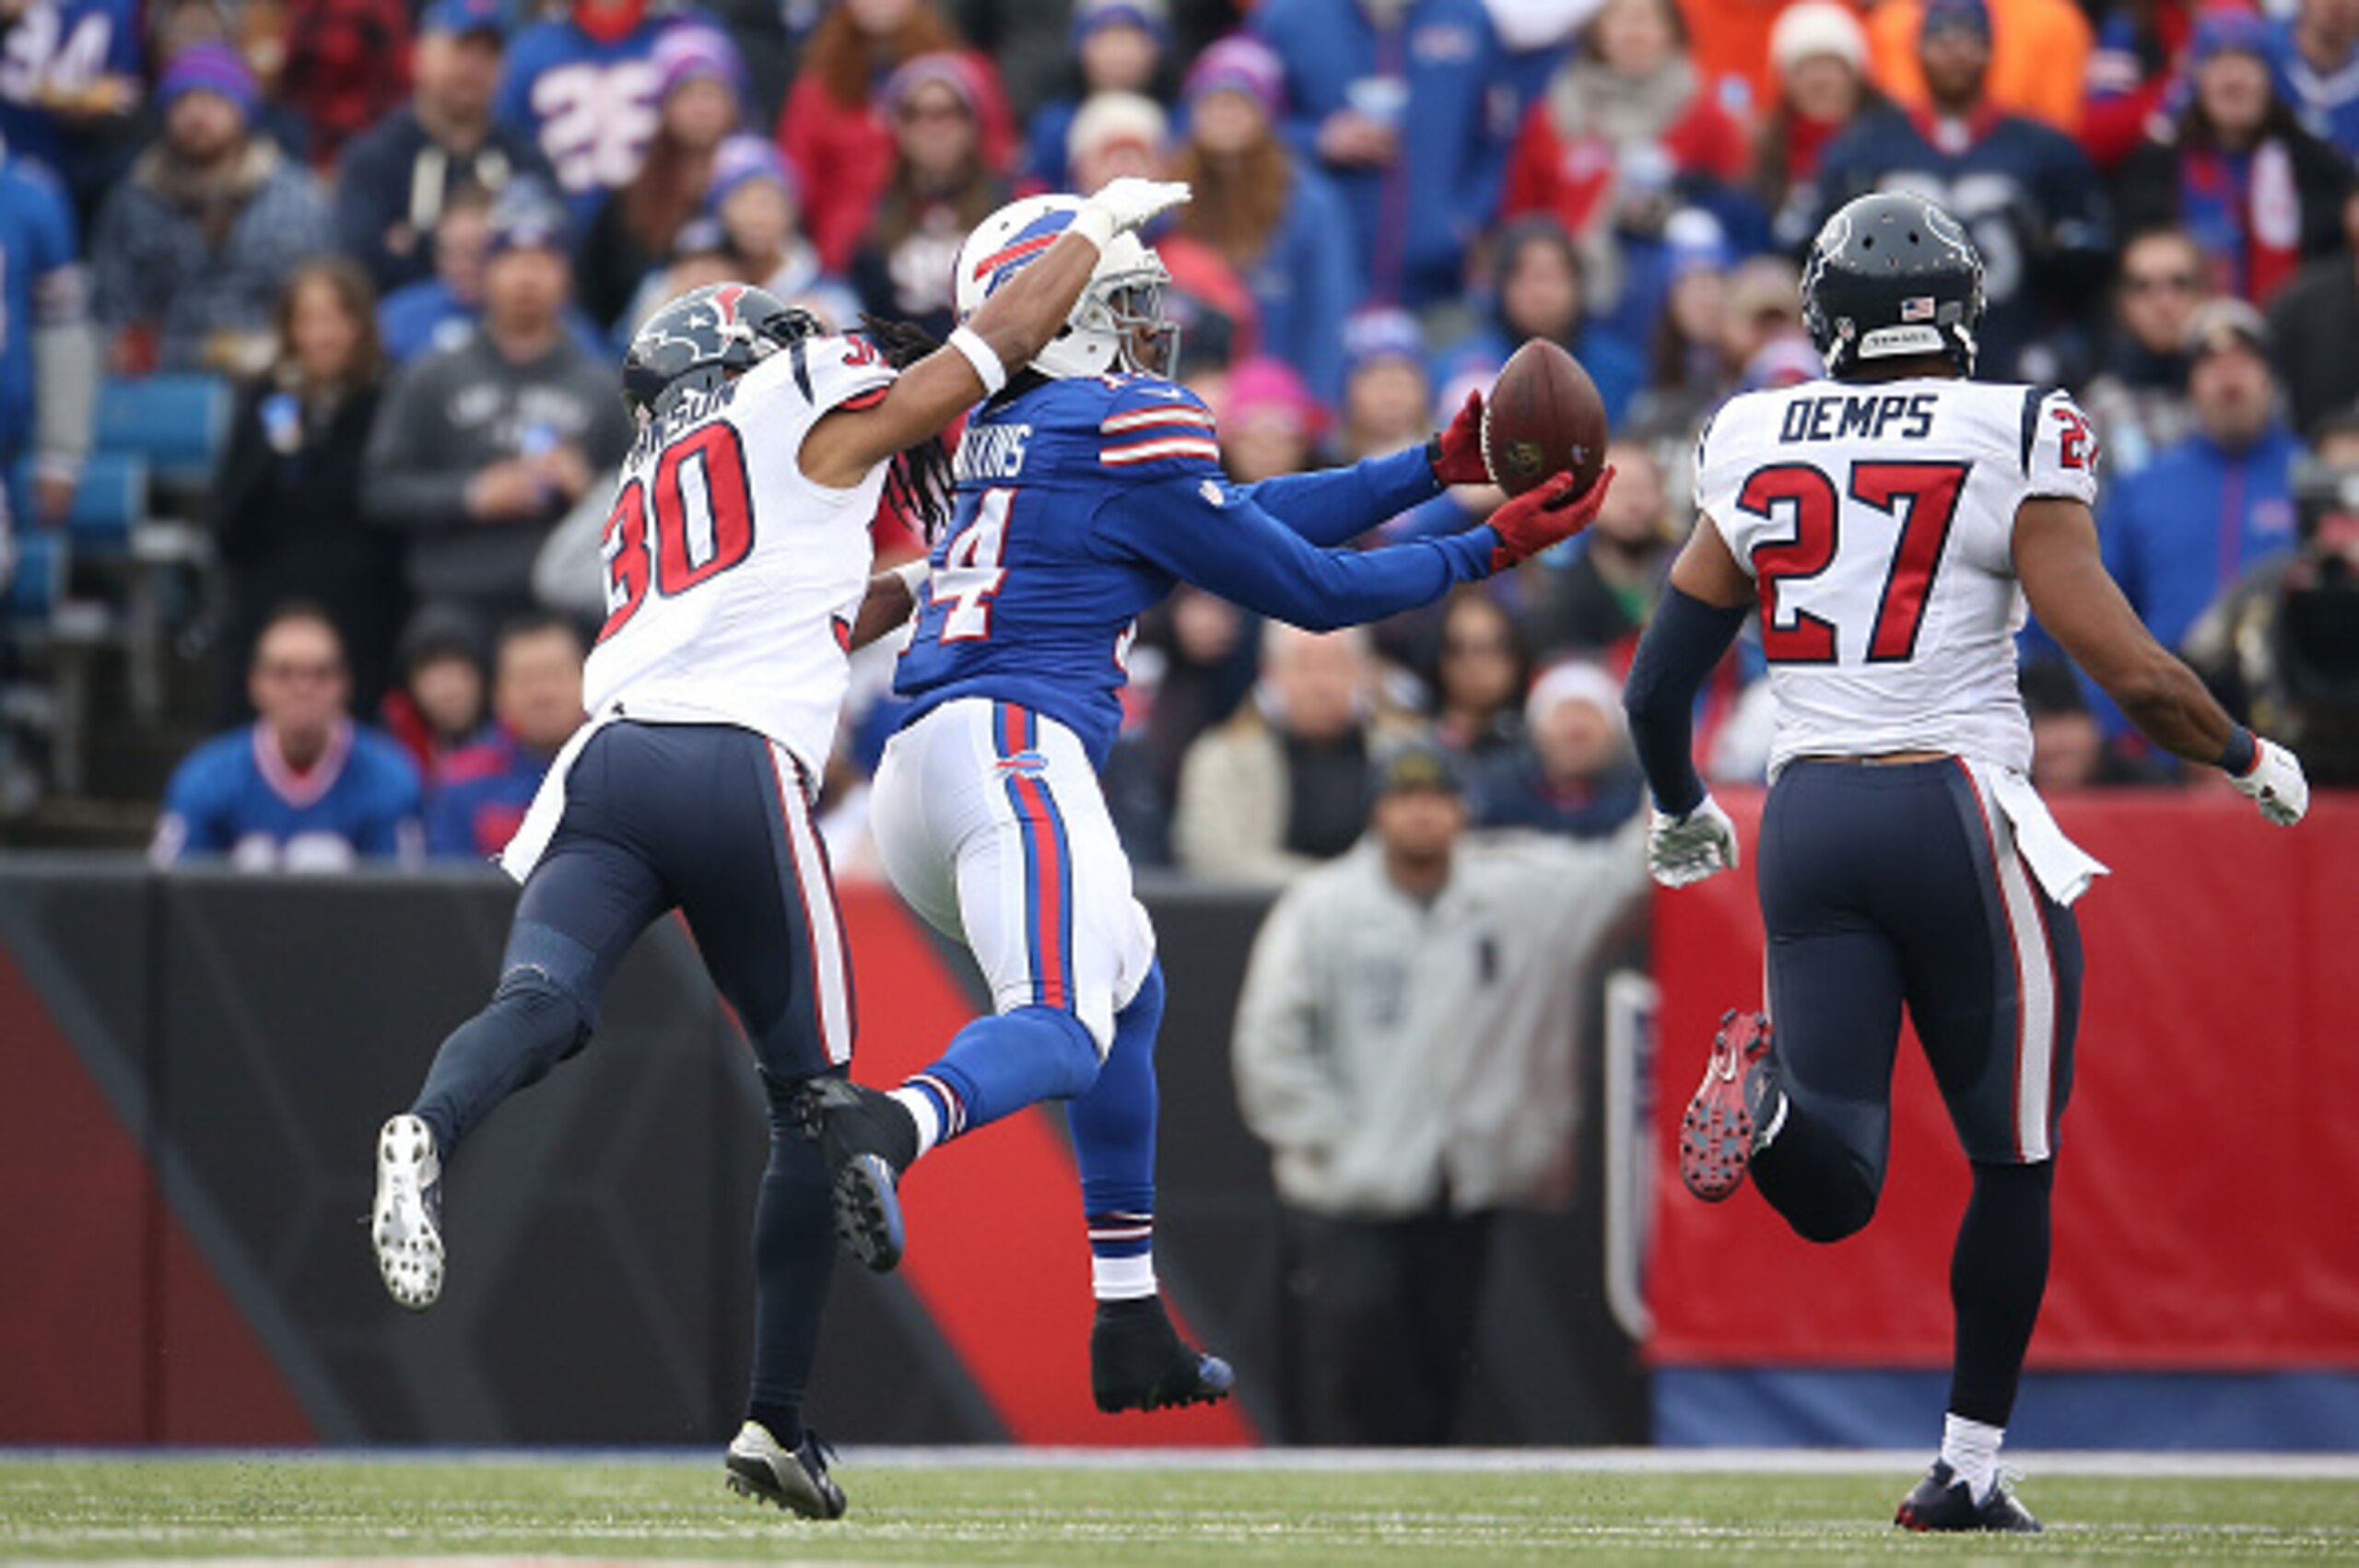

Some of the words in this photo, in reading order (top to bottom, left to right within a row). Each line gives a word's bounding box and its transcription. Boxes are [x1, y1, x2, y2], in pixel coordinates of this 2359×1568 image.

[1778, 393, 1939, 443] DEMPS
[596, 416, 756, 644] 30
[900, 486, 1019, 654] 4
[1736, 460, 1973, 664] 27
